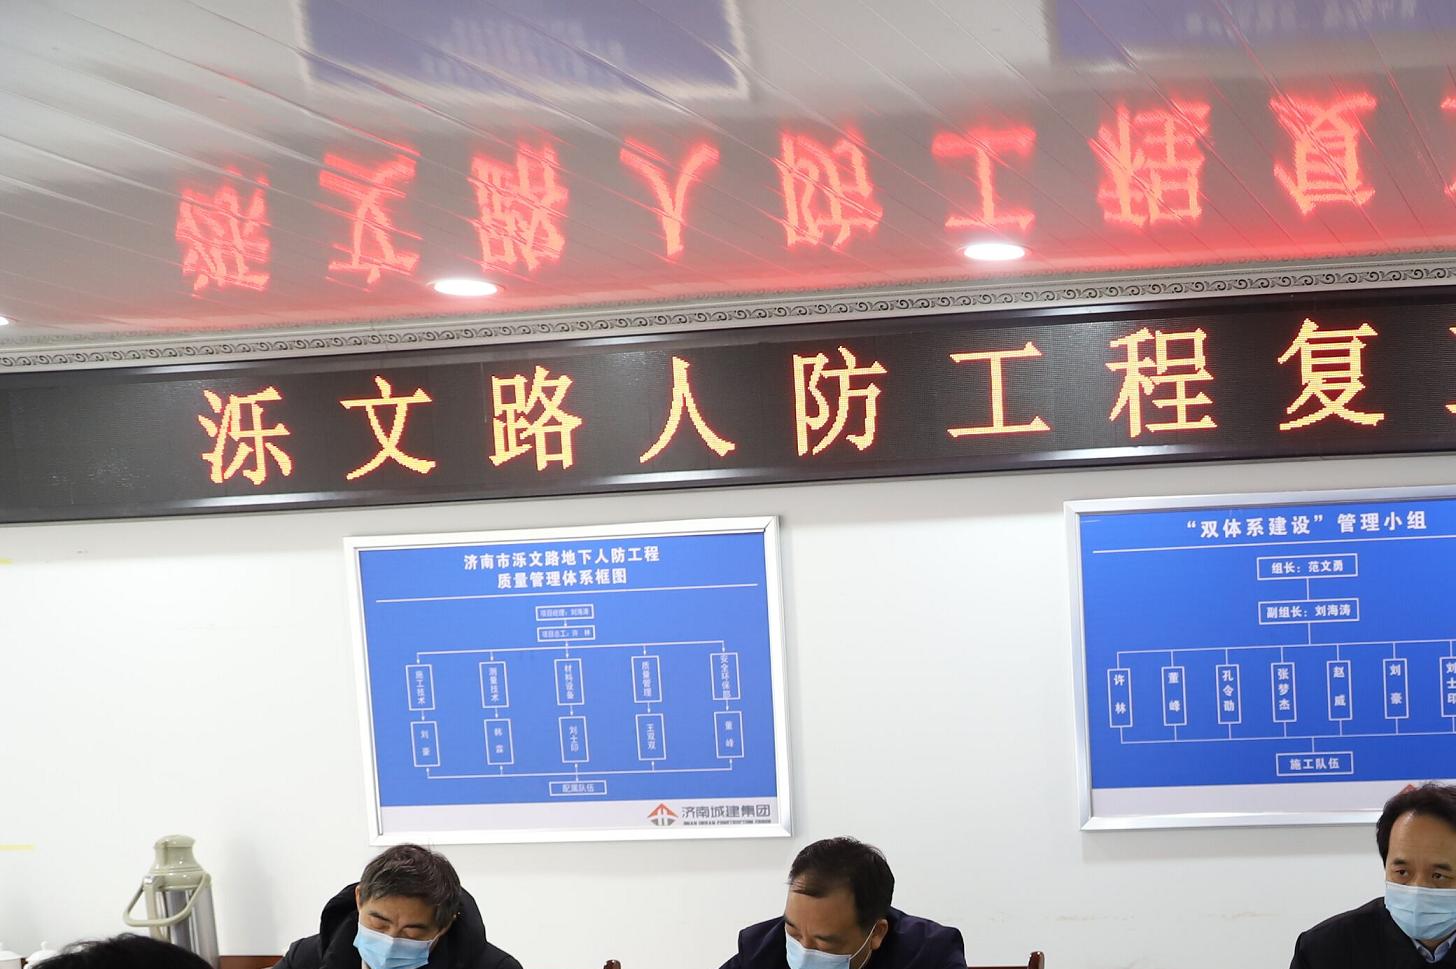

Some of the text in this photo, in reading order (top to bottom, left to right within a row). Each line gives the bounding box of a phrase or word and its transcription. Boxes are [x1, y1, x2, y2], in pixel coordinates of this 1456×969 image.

[463, 545, 660, 571] 济南市泺文路地下人防工程
[1271, 560, 1344, 575] 组长：范文勇
[497, 567, 628, 590] 质量管理体系框图
[1266, 604, 1352, 618] 副组长：刘海涛
[1289, 757, 1340, 771] 施工队伍
[681, 803, 771, 819] 济南城建集团
